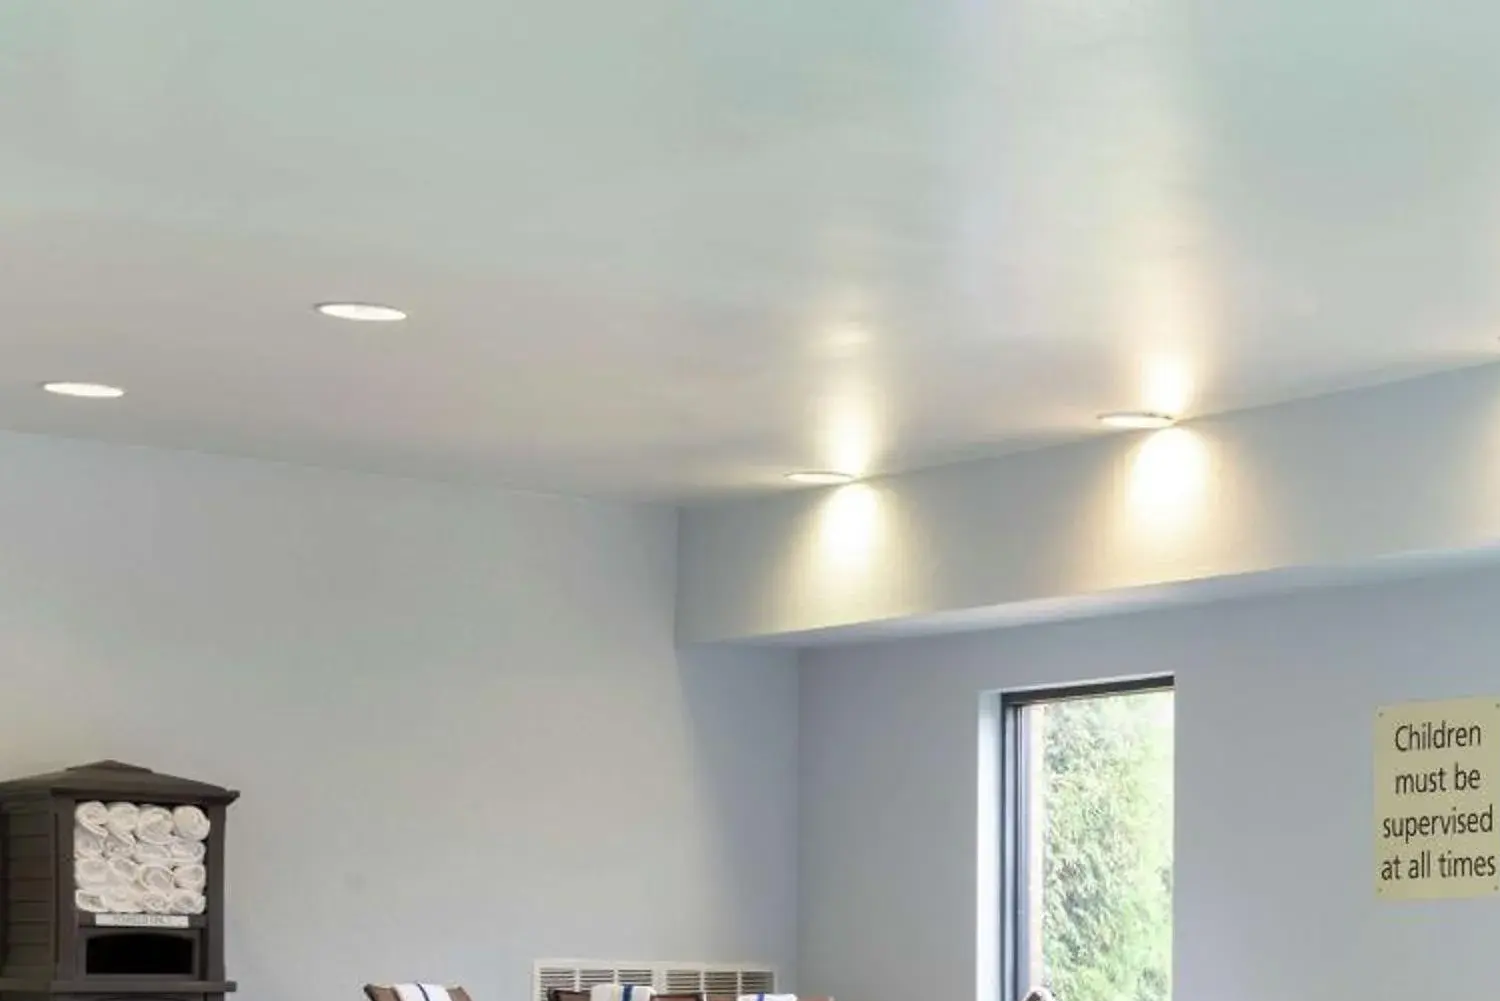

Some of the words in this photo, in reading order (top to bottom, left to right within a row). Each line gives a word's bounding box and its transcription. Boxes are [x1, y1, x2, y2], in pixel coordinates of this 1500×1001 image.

[1394, 720, 1481, 752] Children
[1395, 767, 1447, 794] must
[1454, 762, 1481, 790] be
[1383, 803, 1493, 844] supervised
[1381, 856, 1402, 881] at
[1408, 851, 1431, 879] all
[1437, 850, 1496, 878] times
